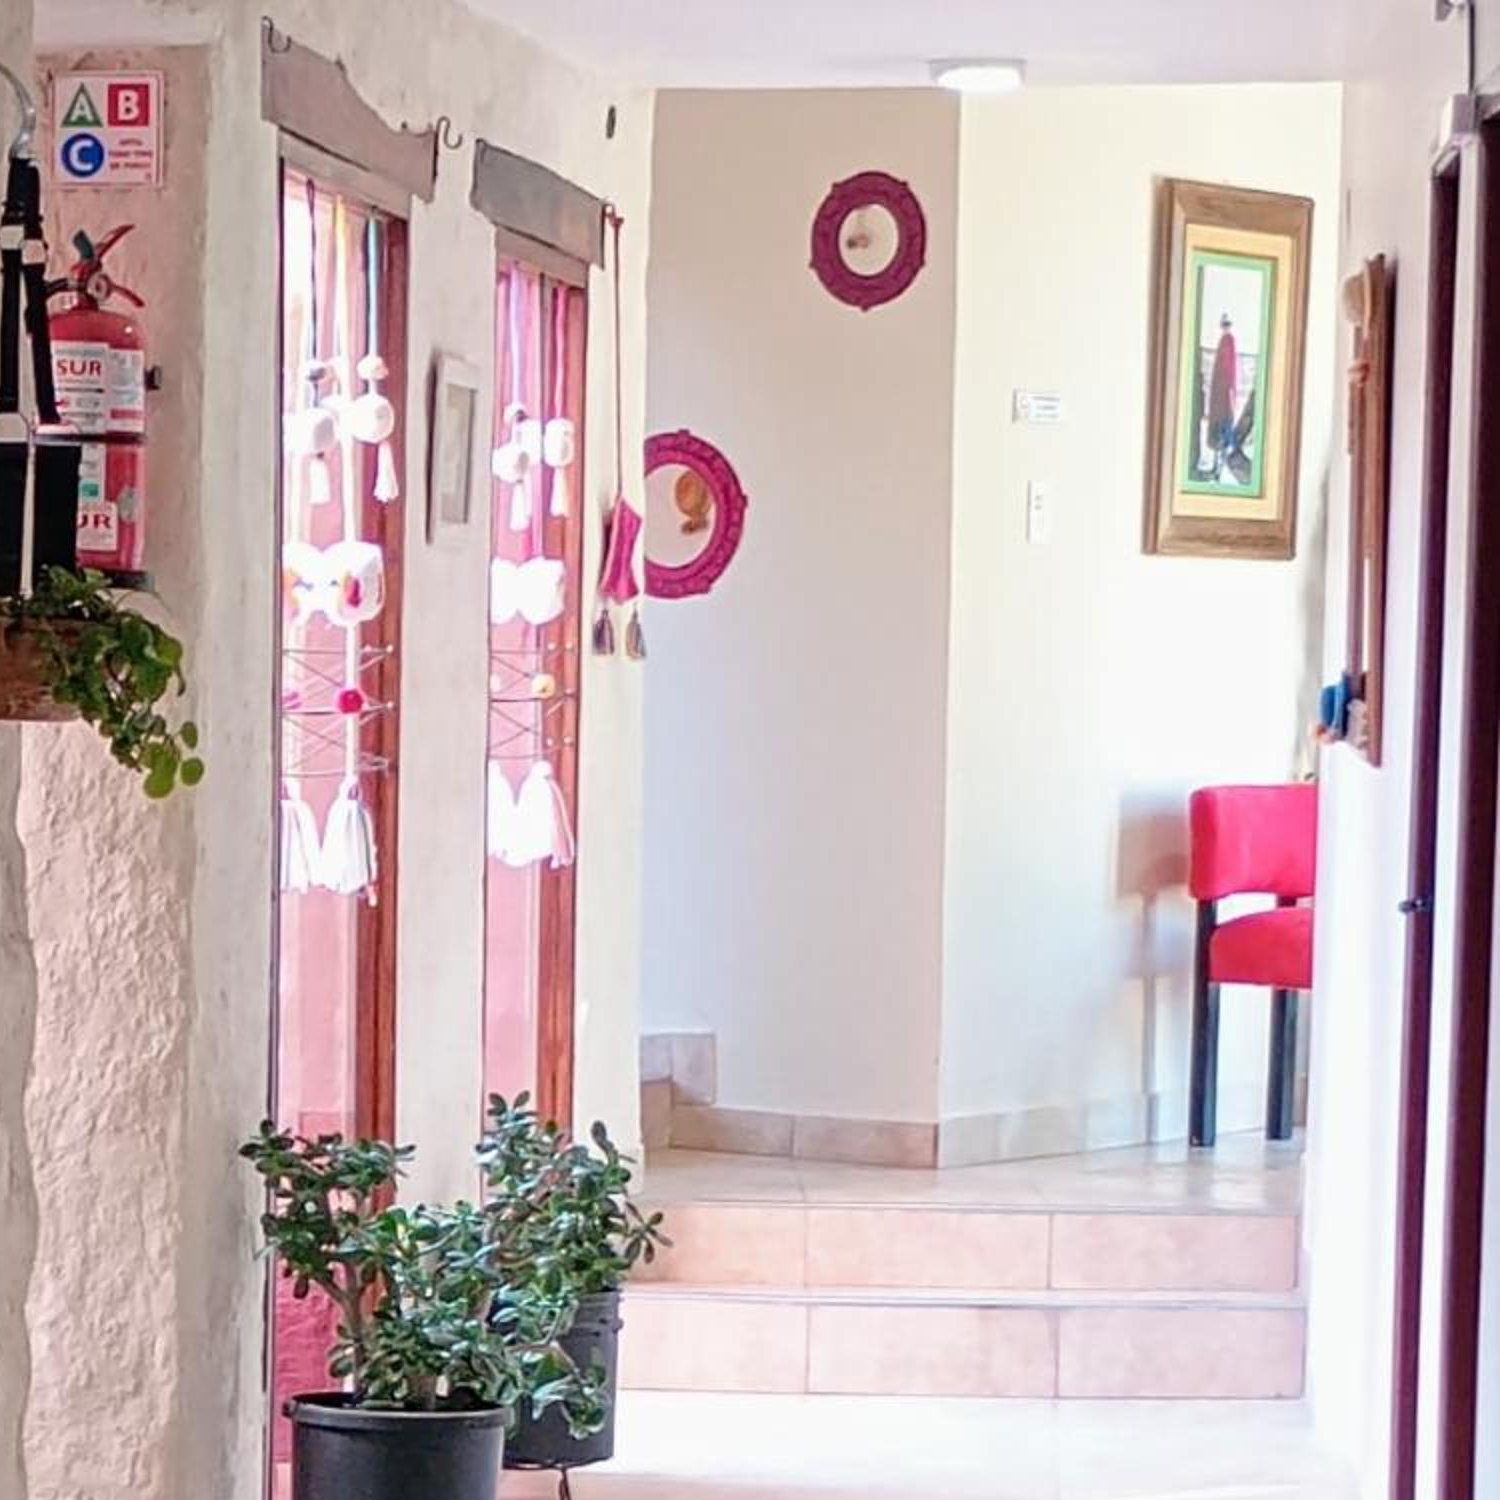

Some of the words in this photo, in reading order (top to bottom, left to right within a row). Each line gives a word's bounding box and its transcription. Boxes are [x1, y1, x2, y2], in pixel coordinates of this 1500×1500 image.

[69, 91, 95, 123] A
[117, 89, 139, 121] B
[68, 138, 95, 172] C
[56, 359, 102, 376] SUR
[77, 513, 112, 529] UR
